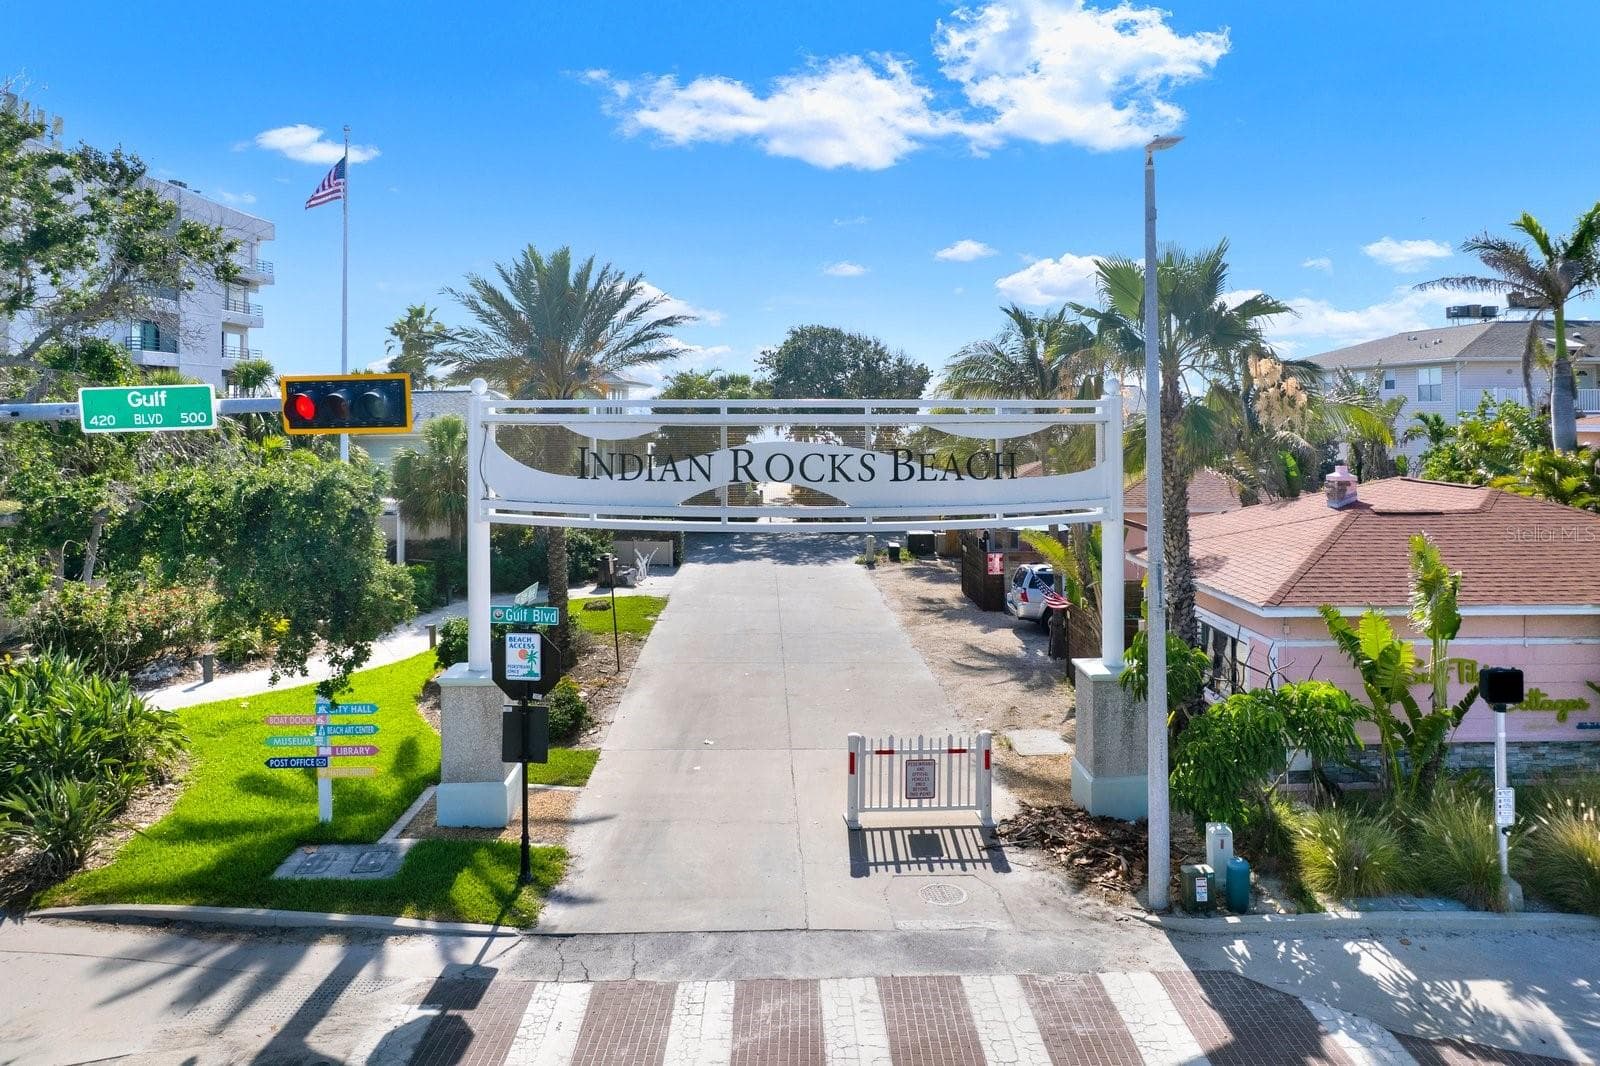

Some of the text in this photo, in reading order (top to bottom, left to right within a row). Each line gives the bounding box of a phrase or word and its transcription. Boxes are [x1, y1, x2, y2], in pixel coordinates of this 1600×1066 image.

[127, 390, 168, 408] Gulf
[89, 412, 207, 427] 420 BLVD 500
[577, 446, 1018, 482] INDIAN ROCKS BEACH
[505, 608, 557, 623] Gulf Blvd
[350, 703, 373, 714] HALL
[1488, 687, 1590, 723] ottages
[268, 716, 316, 725] BOAT DOCKS
[326, 725, 375, 734] BEACH ART CENTER
[273, 737, 311, 746] MUSEUM
[335, 747, 370, 756] LIBRARY
[269, 758, 315, 768] POST OFFICE
